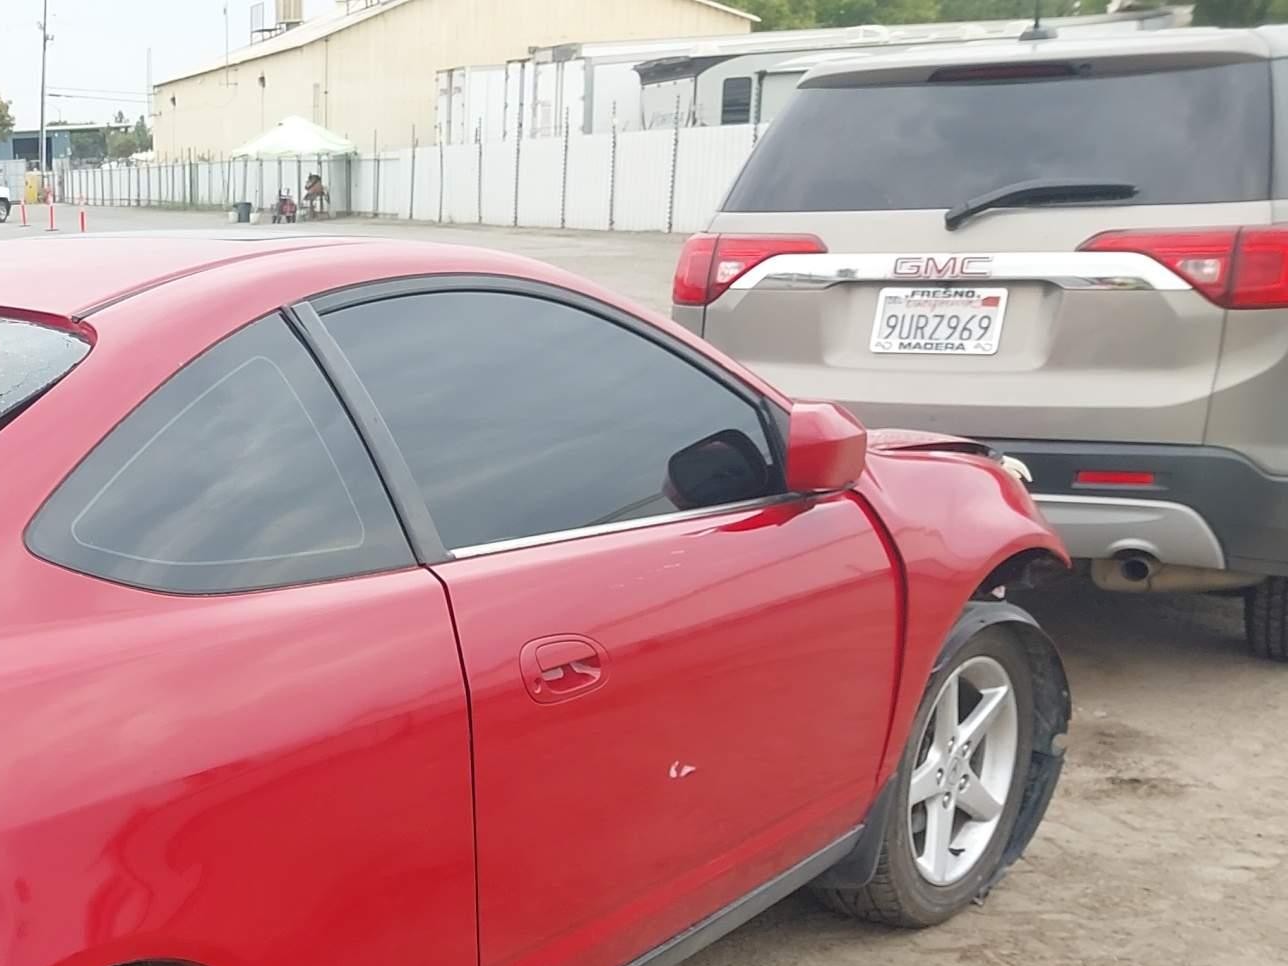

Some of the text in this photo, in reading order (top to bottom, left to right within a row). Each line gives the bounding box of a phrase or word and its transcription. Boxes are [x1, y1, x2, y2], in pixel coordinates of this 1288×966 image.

[893, 256, 992, 279] GMC
[910, 289, 976, 299] FRESNO
[884, 314, 992, 341] 9URZ969
[898, 342, 966, 351] MADERA
